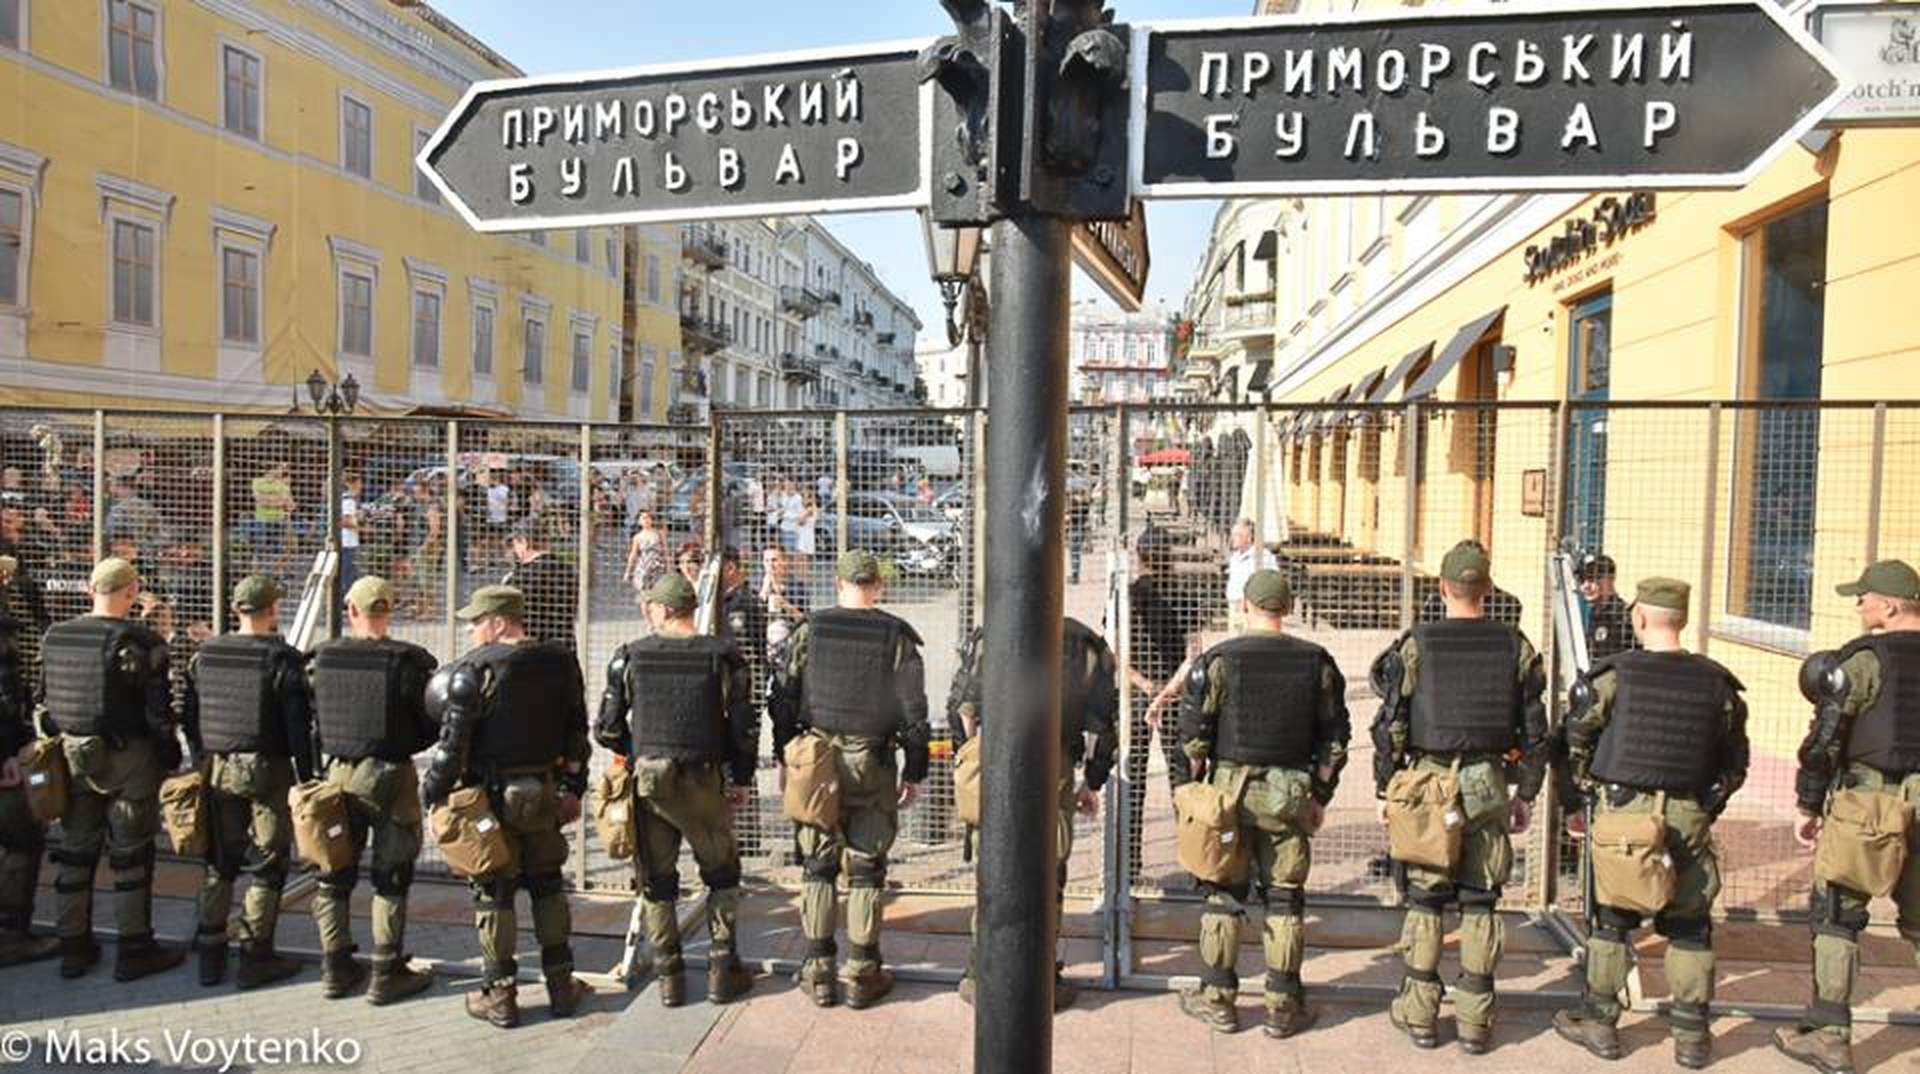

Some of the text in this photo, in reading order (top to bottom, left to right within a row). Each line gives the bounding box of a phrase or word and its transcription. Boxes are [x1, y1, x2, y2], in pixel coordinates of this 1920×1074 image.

[1199, 20, 1694, 96] ПРИМОРСЬКИЙ
[502, 68, 861, 146] ПРИМОРСЬКИЙ
[1206, 102, 1681, 159] БУЛЬВАР
[509, 137, 863, 203] БУЛЬВАР
